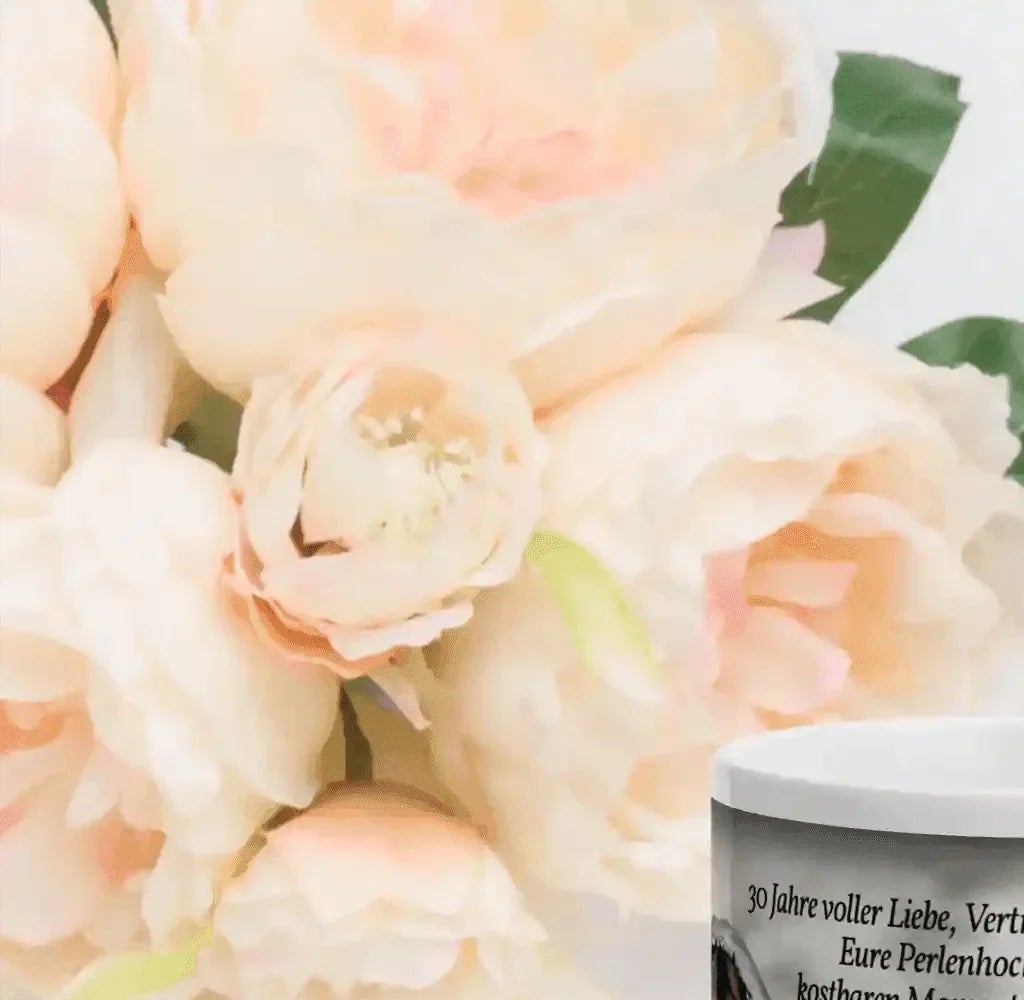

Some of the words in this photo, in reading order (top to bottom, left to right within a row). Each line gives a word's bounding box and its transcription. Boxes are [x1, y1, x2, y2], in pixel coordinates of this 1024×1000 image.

[747, 885, 768, 914] 30
[768, 882, 819, 920] Jahre
[821, 892, 884, 926] voller
[887, 897, 957, 939] Liebe,
[838, 935, 893, 971] Eure
